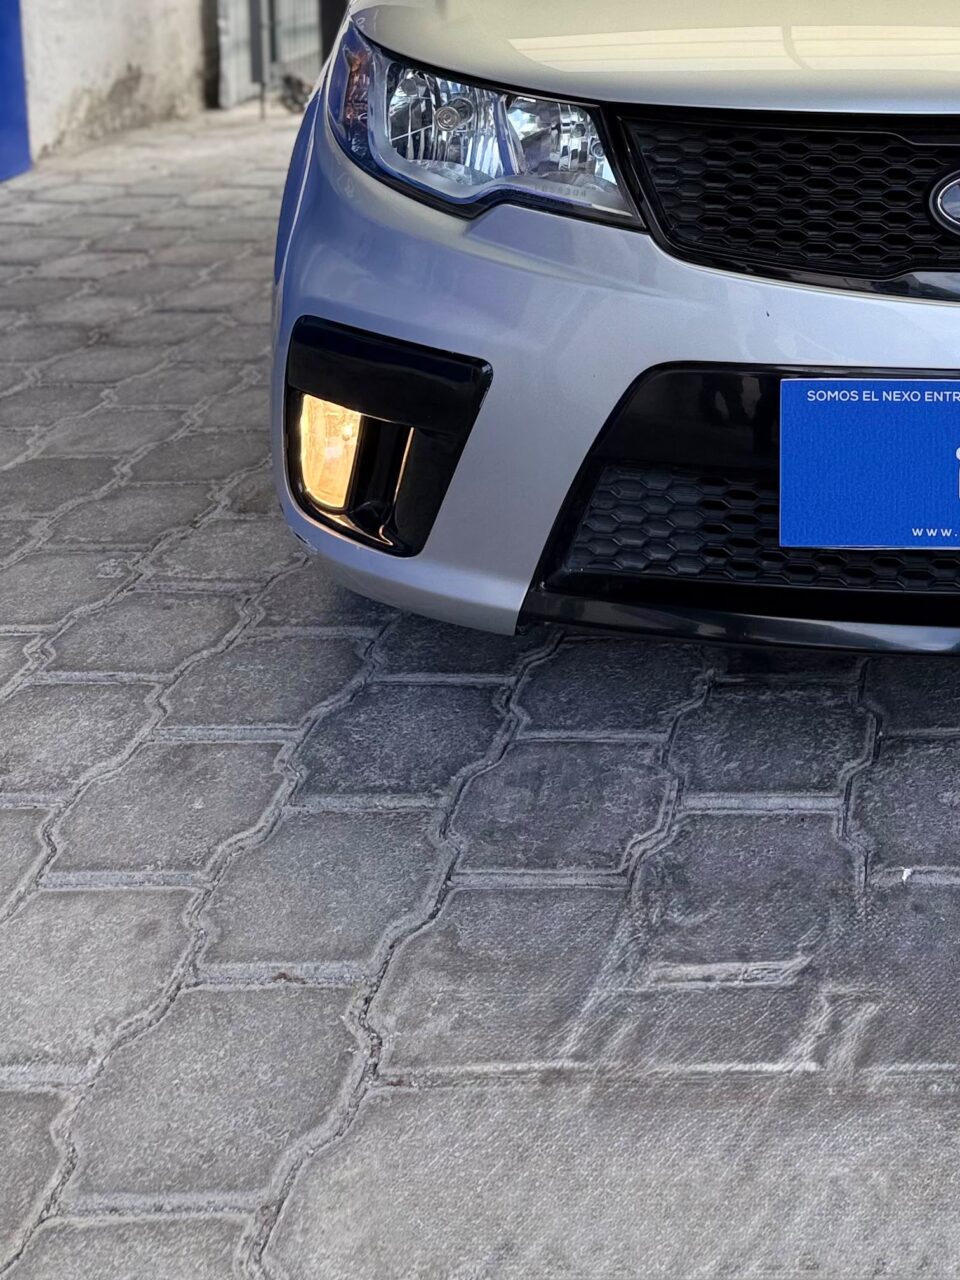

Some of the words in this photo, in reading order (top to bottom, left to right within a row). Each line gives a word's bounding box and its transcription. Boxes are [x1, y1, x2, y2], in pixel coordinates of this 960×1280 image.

[807, 390, 859, 402] SOMOS
[862, 390, 879, 402] EL
[882, 390, 921, 402] NEXO
